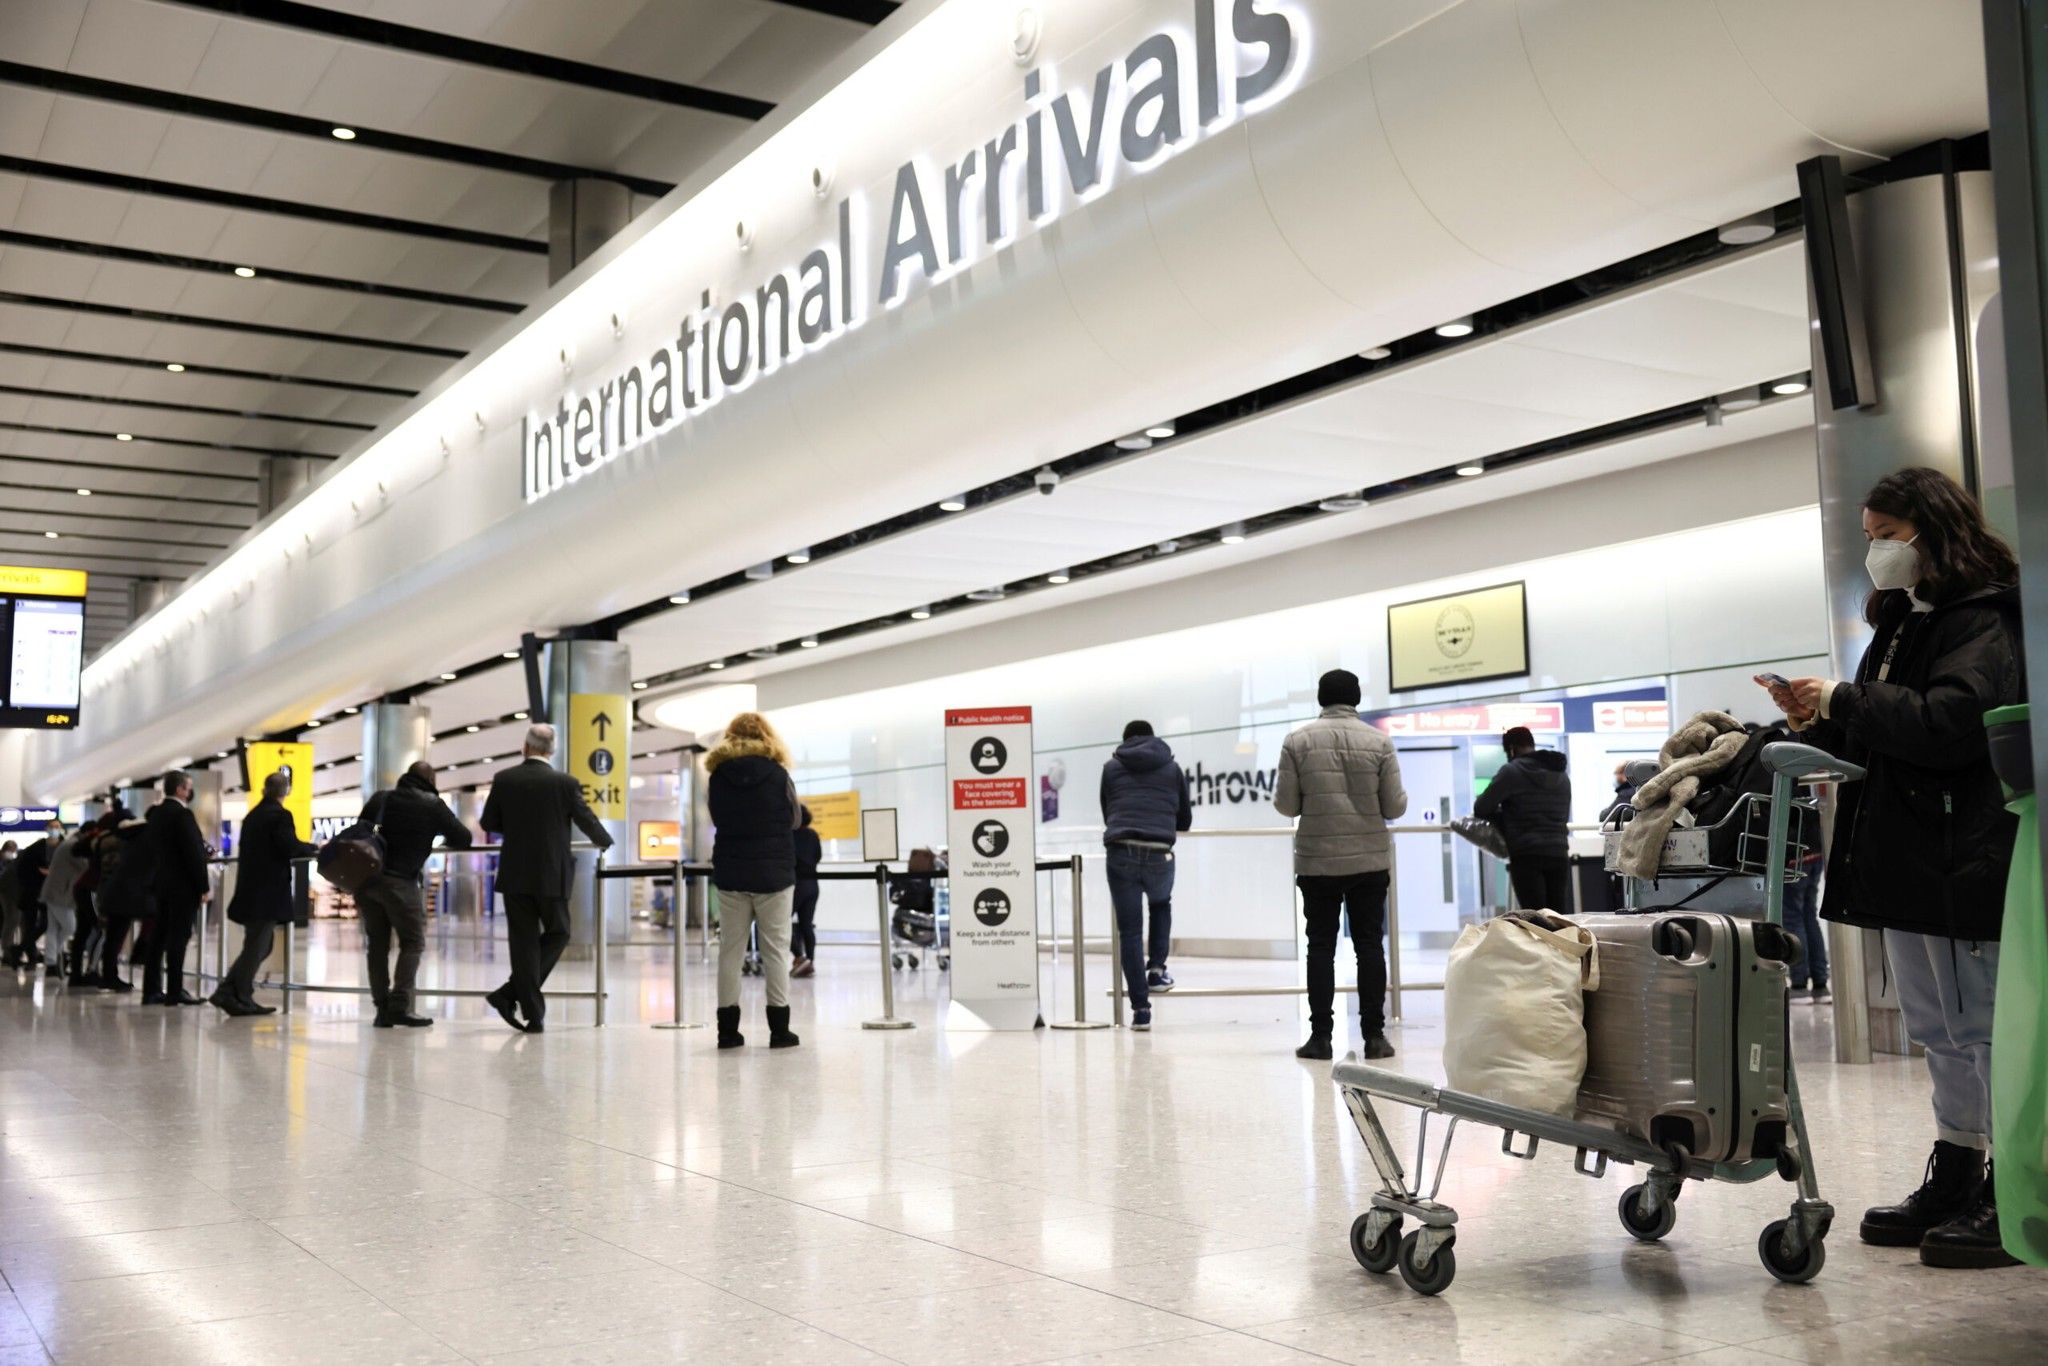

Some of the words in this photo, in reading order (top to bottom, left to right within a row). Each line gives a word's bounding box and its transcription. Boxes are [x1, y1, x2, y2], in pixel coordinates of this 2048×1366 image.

[522, 196, 854, 499] International
[877, 0, 1292, 304] Arrivals
[958, 716, 979, 724] Public
[1183, 761, 1277, 807] throw
[578, 783, 621, 804] Exit
[964, 790, 981, 798] face
[981, 790, 1015, 799] covering
[985, 798, 1018, 806] terminal
[987, 869, 1020, 878] regularly
[956, 930, 976, 938] Keep
[999, 929, 1031, 937] distance
[997, 982, 1031, 990] Heathrow
